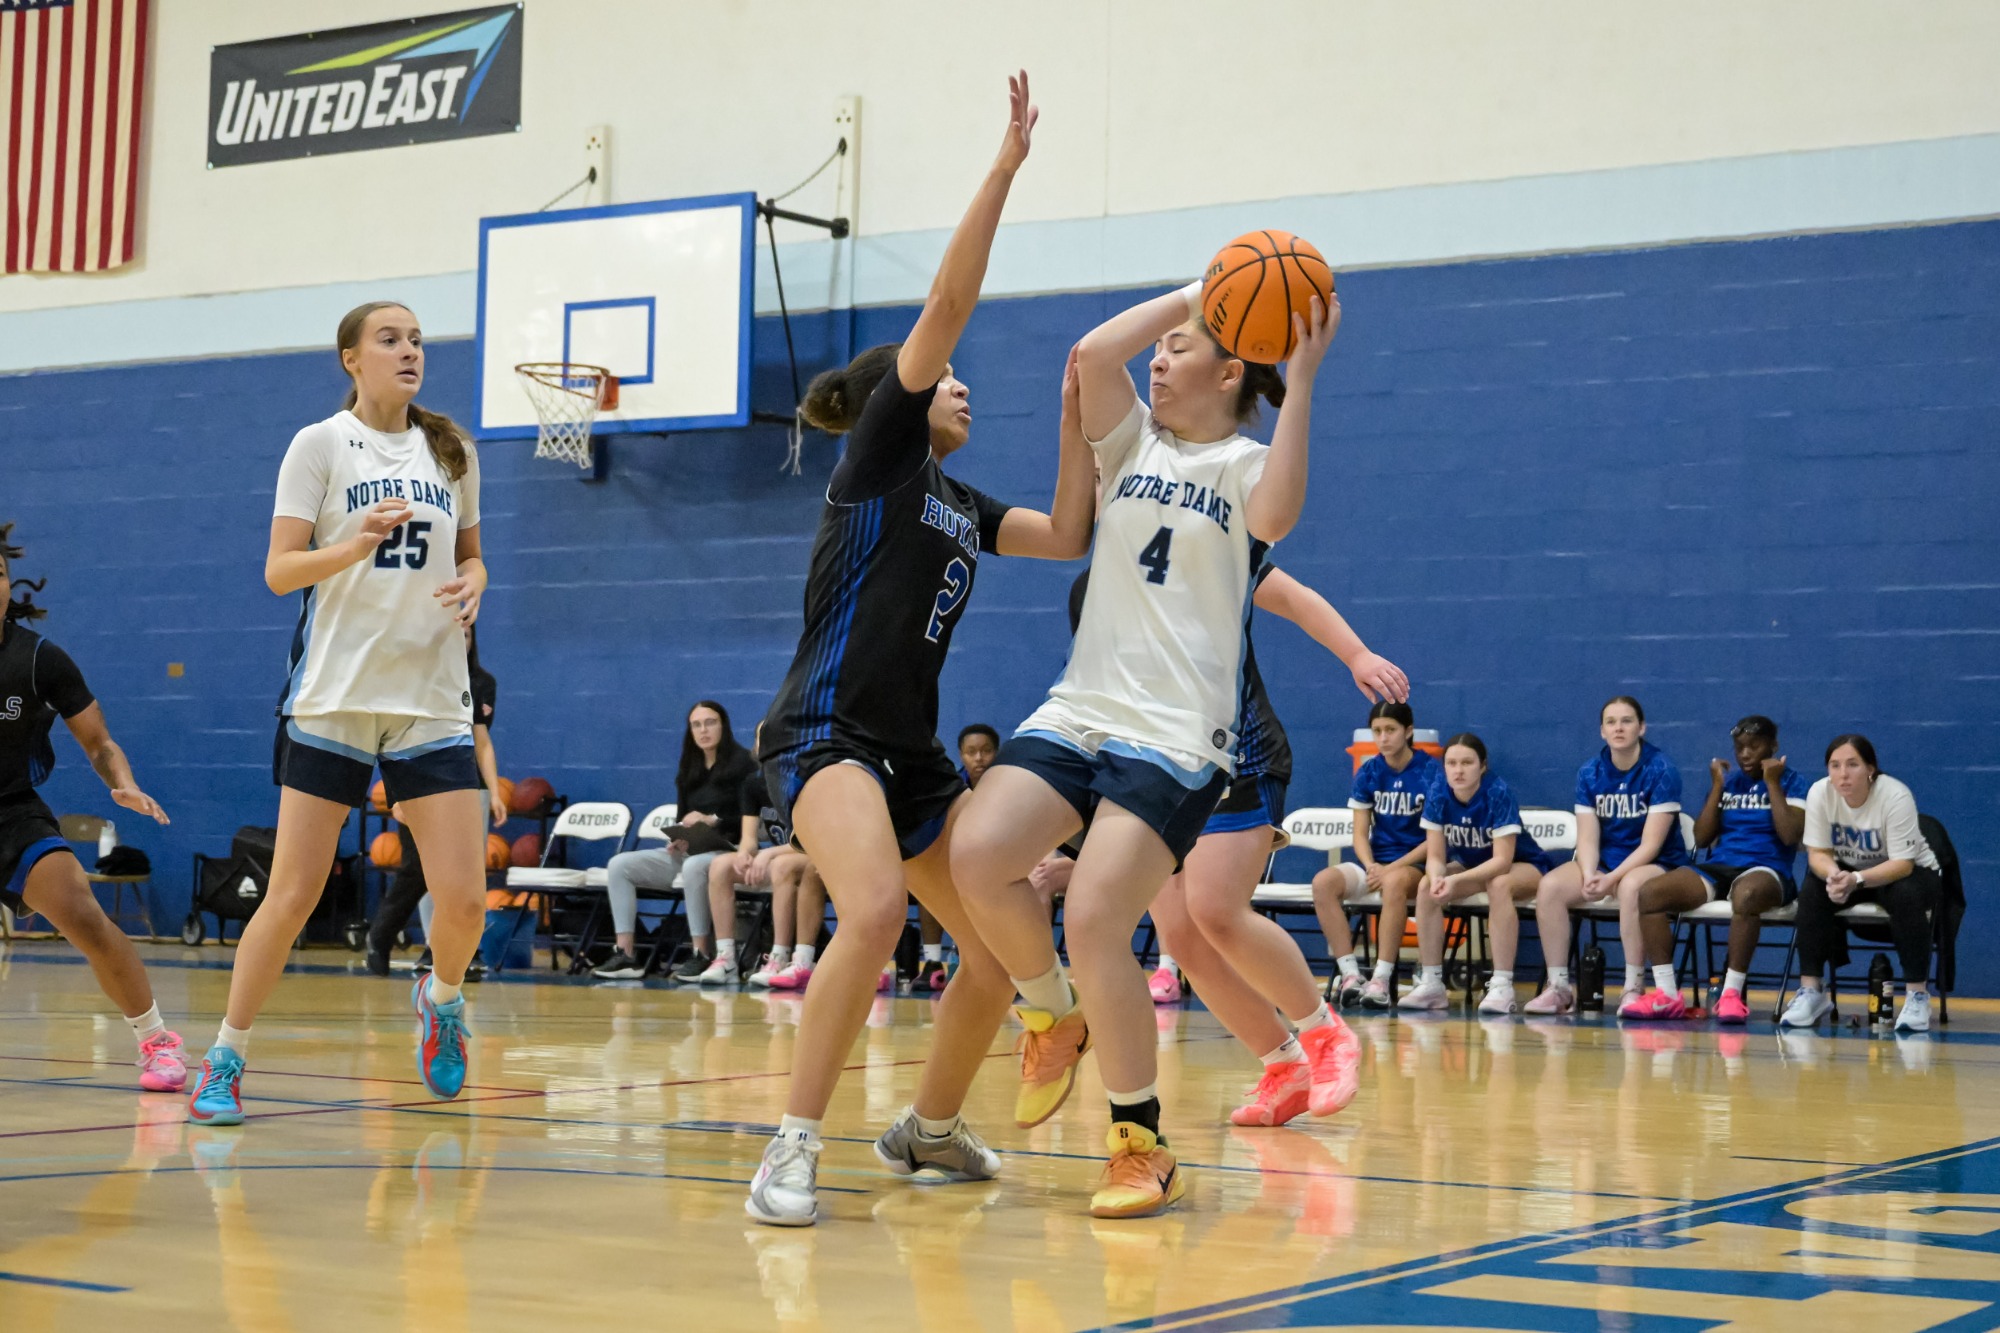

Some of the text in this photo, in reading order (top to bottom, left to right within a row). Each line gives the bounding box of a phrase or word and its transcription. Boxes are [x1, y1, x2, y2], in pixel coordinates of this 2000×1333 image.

[346, 479, 452, 518] NOTRE DAME
[1112, 474, 1232, 535] NOTRE DAME
[374, 521, 432, 570] 25
[1139, 526, 1174, 585] 4
[925, 557, 969, 643] 2
[1374, 790, 1424, 815] ROYALS
[1596, 793, 1648, 818] ROYALS
[568, 813, 619, 826] GATORS
[1292, 821, 1354, 836] GATORS
[1444, 824, 1494, 849] ROYALS
[1831, 823, 1882, 851] EMU
